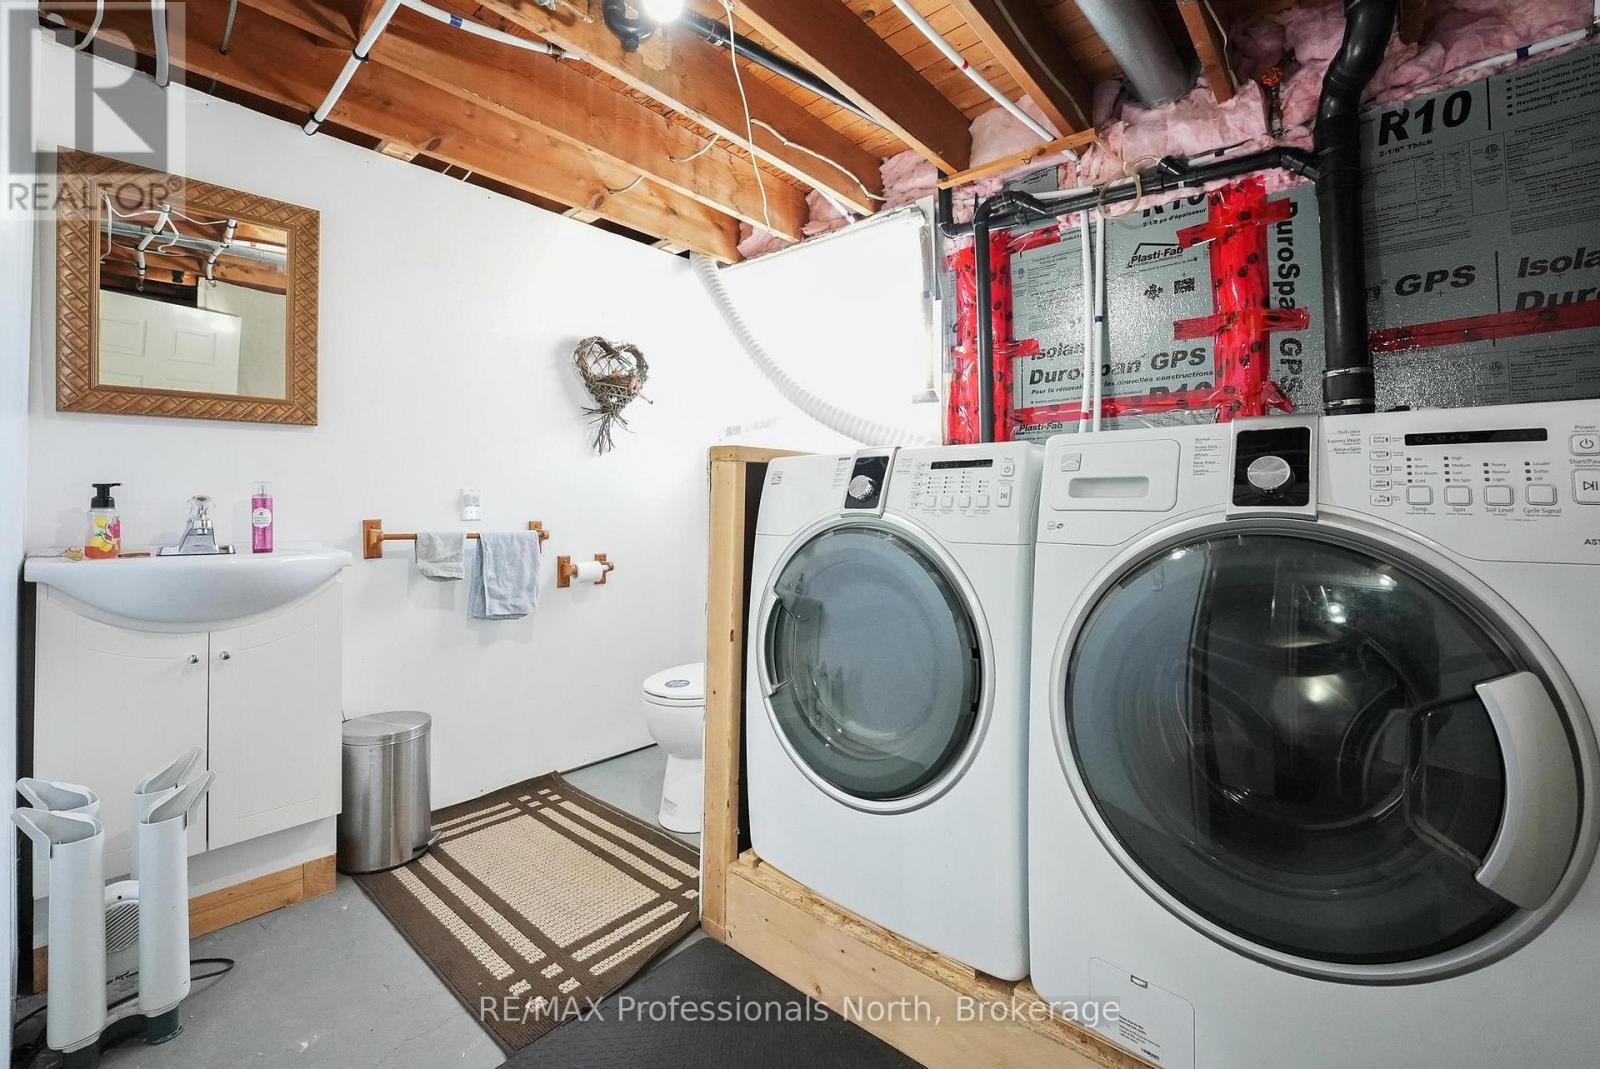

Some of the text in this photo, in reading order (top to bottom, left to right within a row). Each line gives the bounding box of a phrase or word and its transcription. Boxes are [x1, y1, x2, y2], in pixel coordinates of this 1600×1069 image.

[1378, 90, 1472, 146] R10
[1407, 139, 1433, 150] Thick
[1394, 265, 1477, 296] GPS
[1150, 347, 1206, 370] GPS
[1279, 337, 1304, 394] GPS
[1155, 370, 1214, 381] constructions
